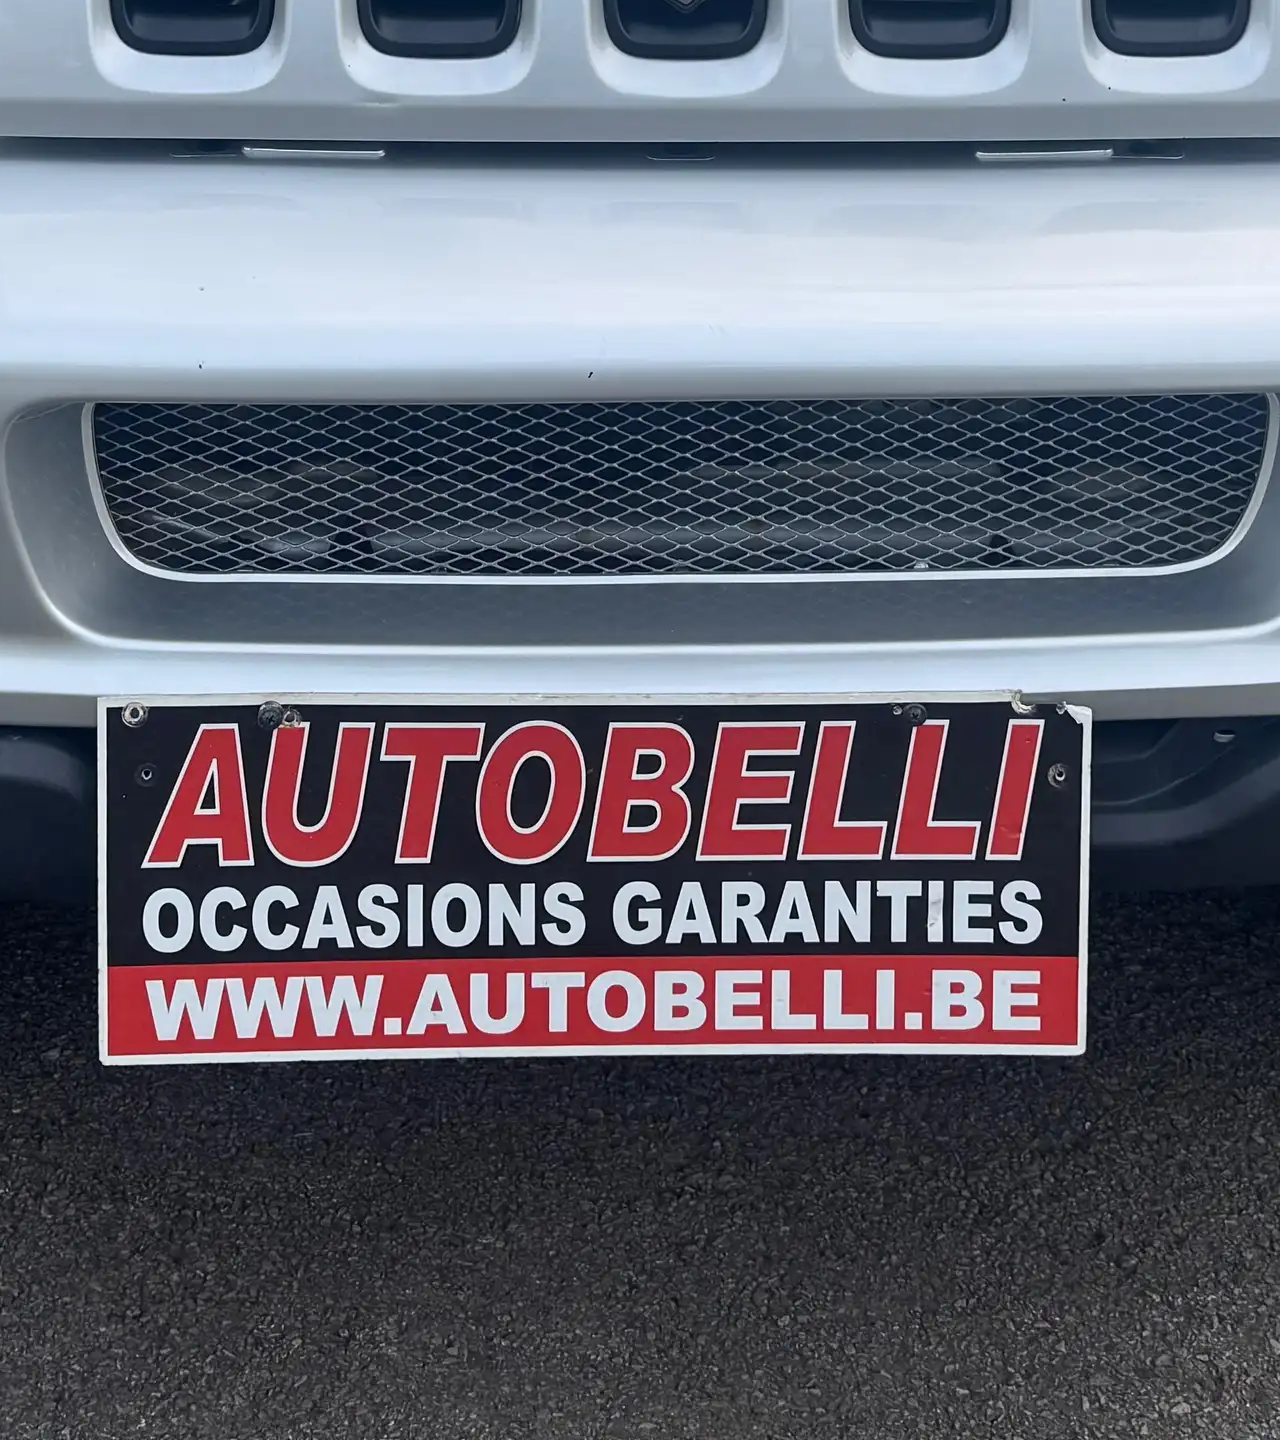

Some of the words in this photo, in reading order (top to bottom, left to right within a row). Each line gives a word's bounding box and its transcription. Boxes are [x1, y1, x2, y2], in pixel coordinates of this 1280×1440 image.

[141, 718, 1045, 869] AUTOBELLI
[141, 881, 587, 952] OCCASIONS
[611, 878, 1044, 946] GARANTIES
[144, 967, 1043, 1041] WWW.AUTOBELLI.BE
